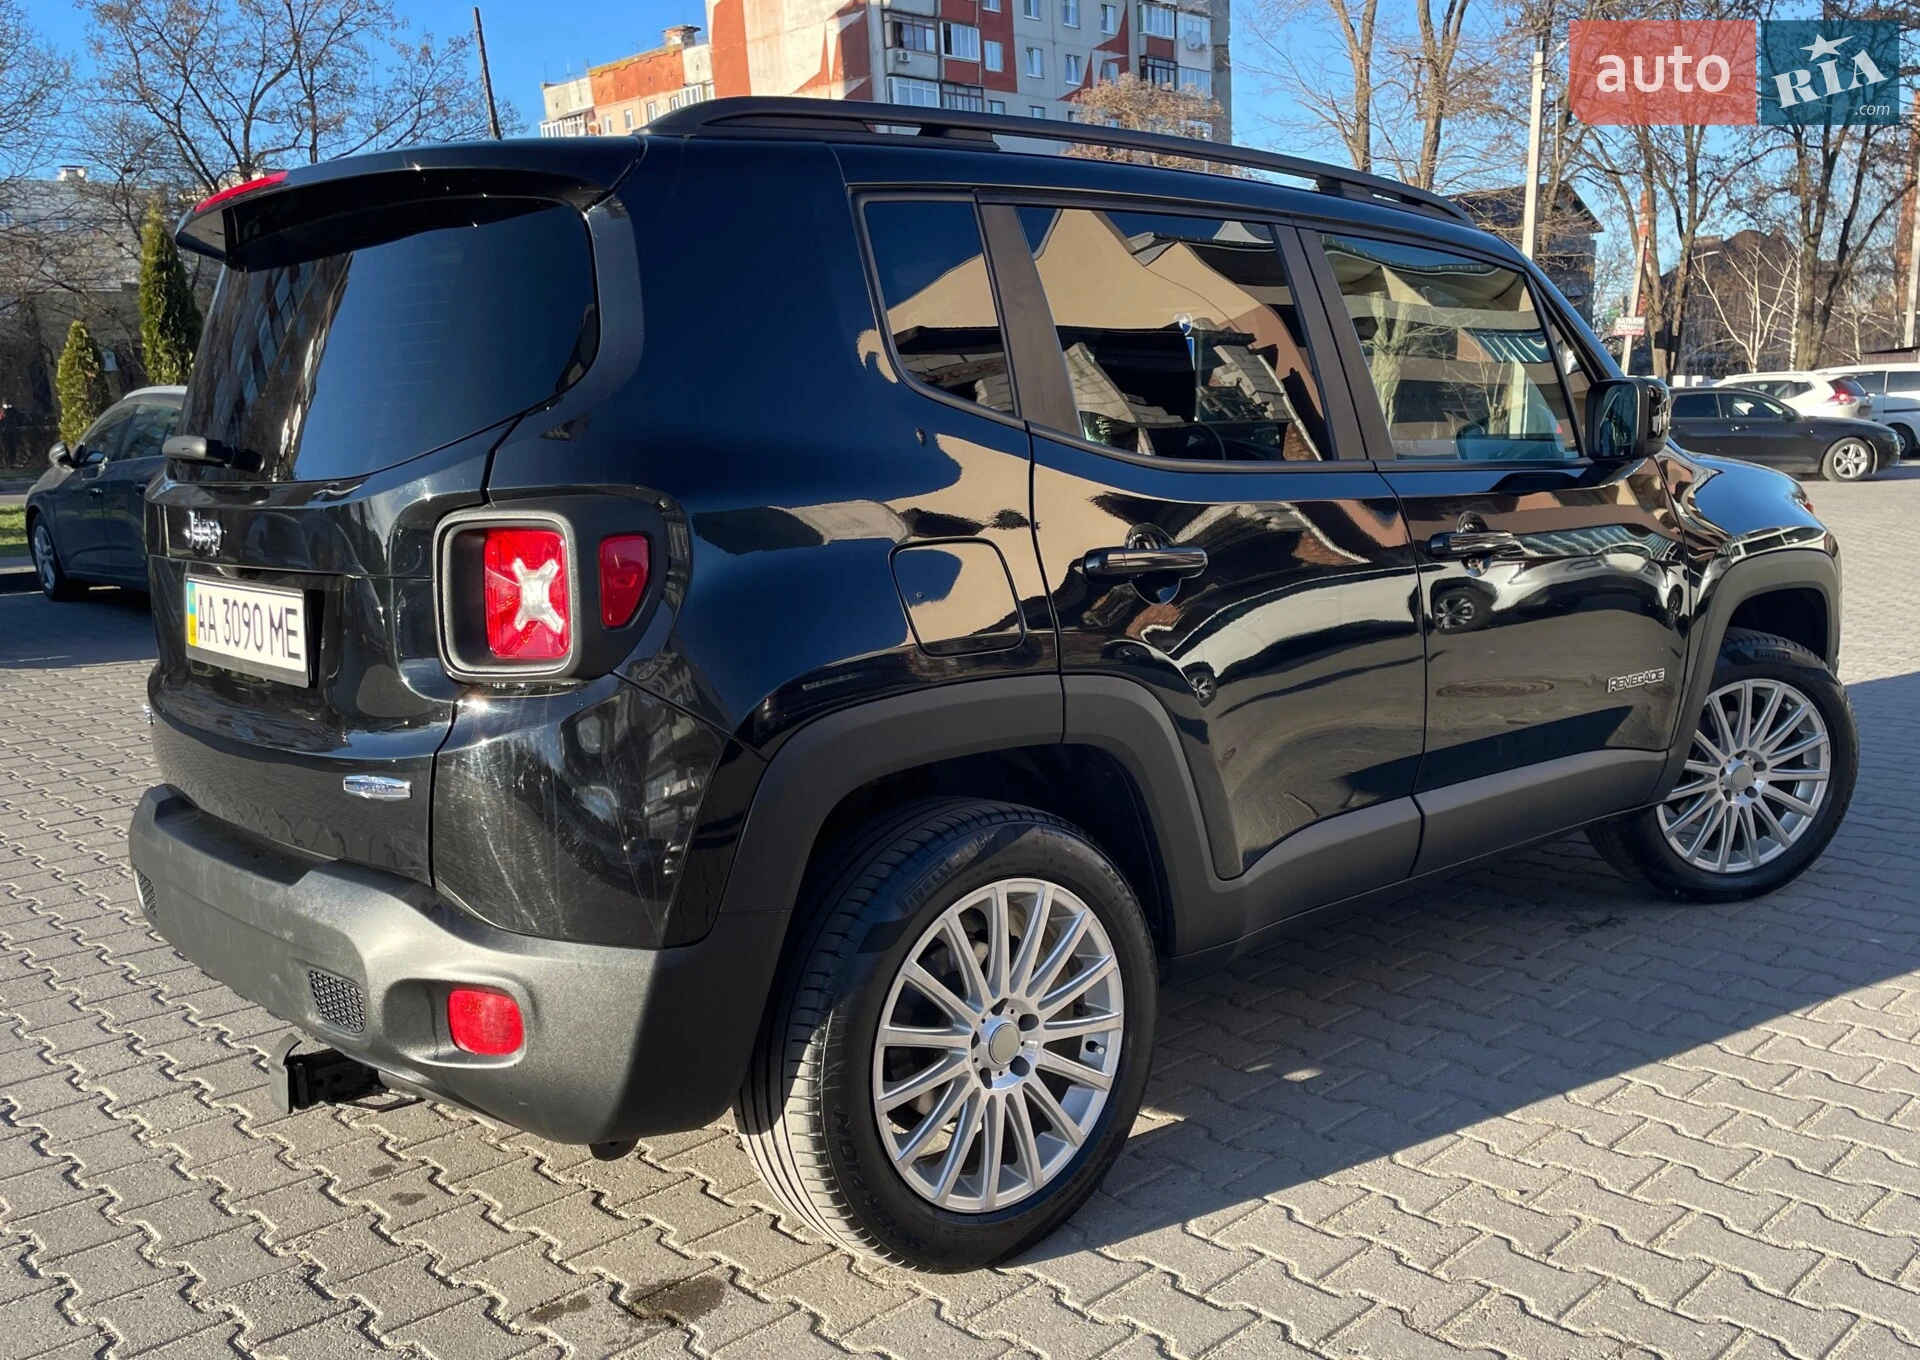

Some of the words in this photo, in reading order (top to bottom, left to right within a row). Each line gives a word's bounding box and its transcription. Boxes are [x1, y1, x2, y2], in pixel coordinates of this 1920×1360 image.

[183, 509, 222, 557] Jeep
[198, 593, 218, 644] AA
[223, 597, 264, 653] 3090
[268, 604, 302, 660] ME
[1606, 668, 1665, 693] RENEGADE
